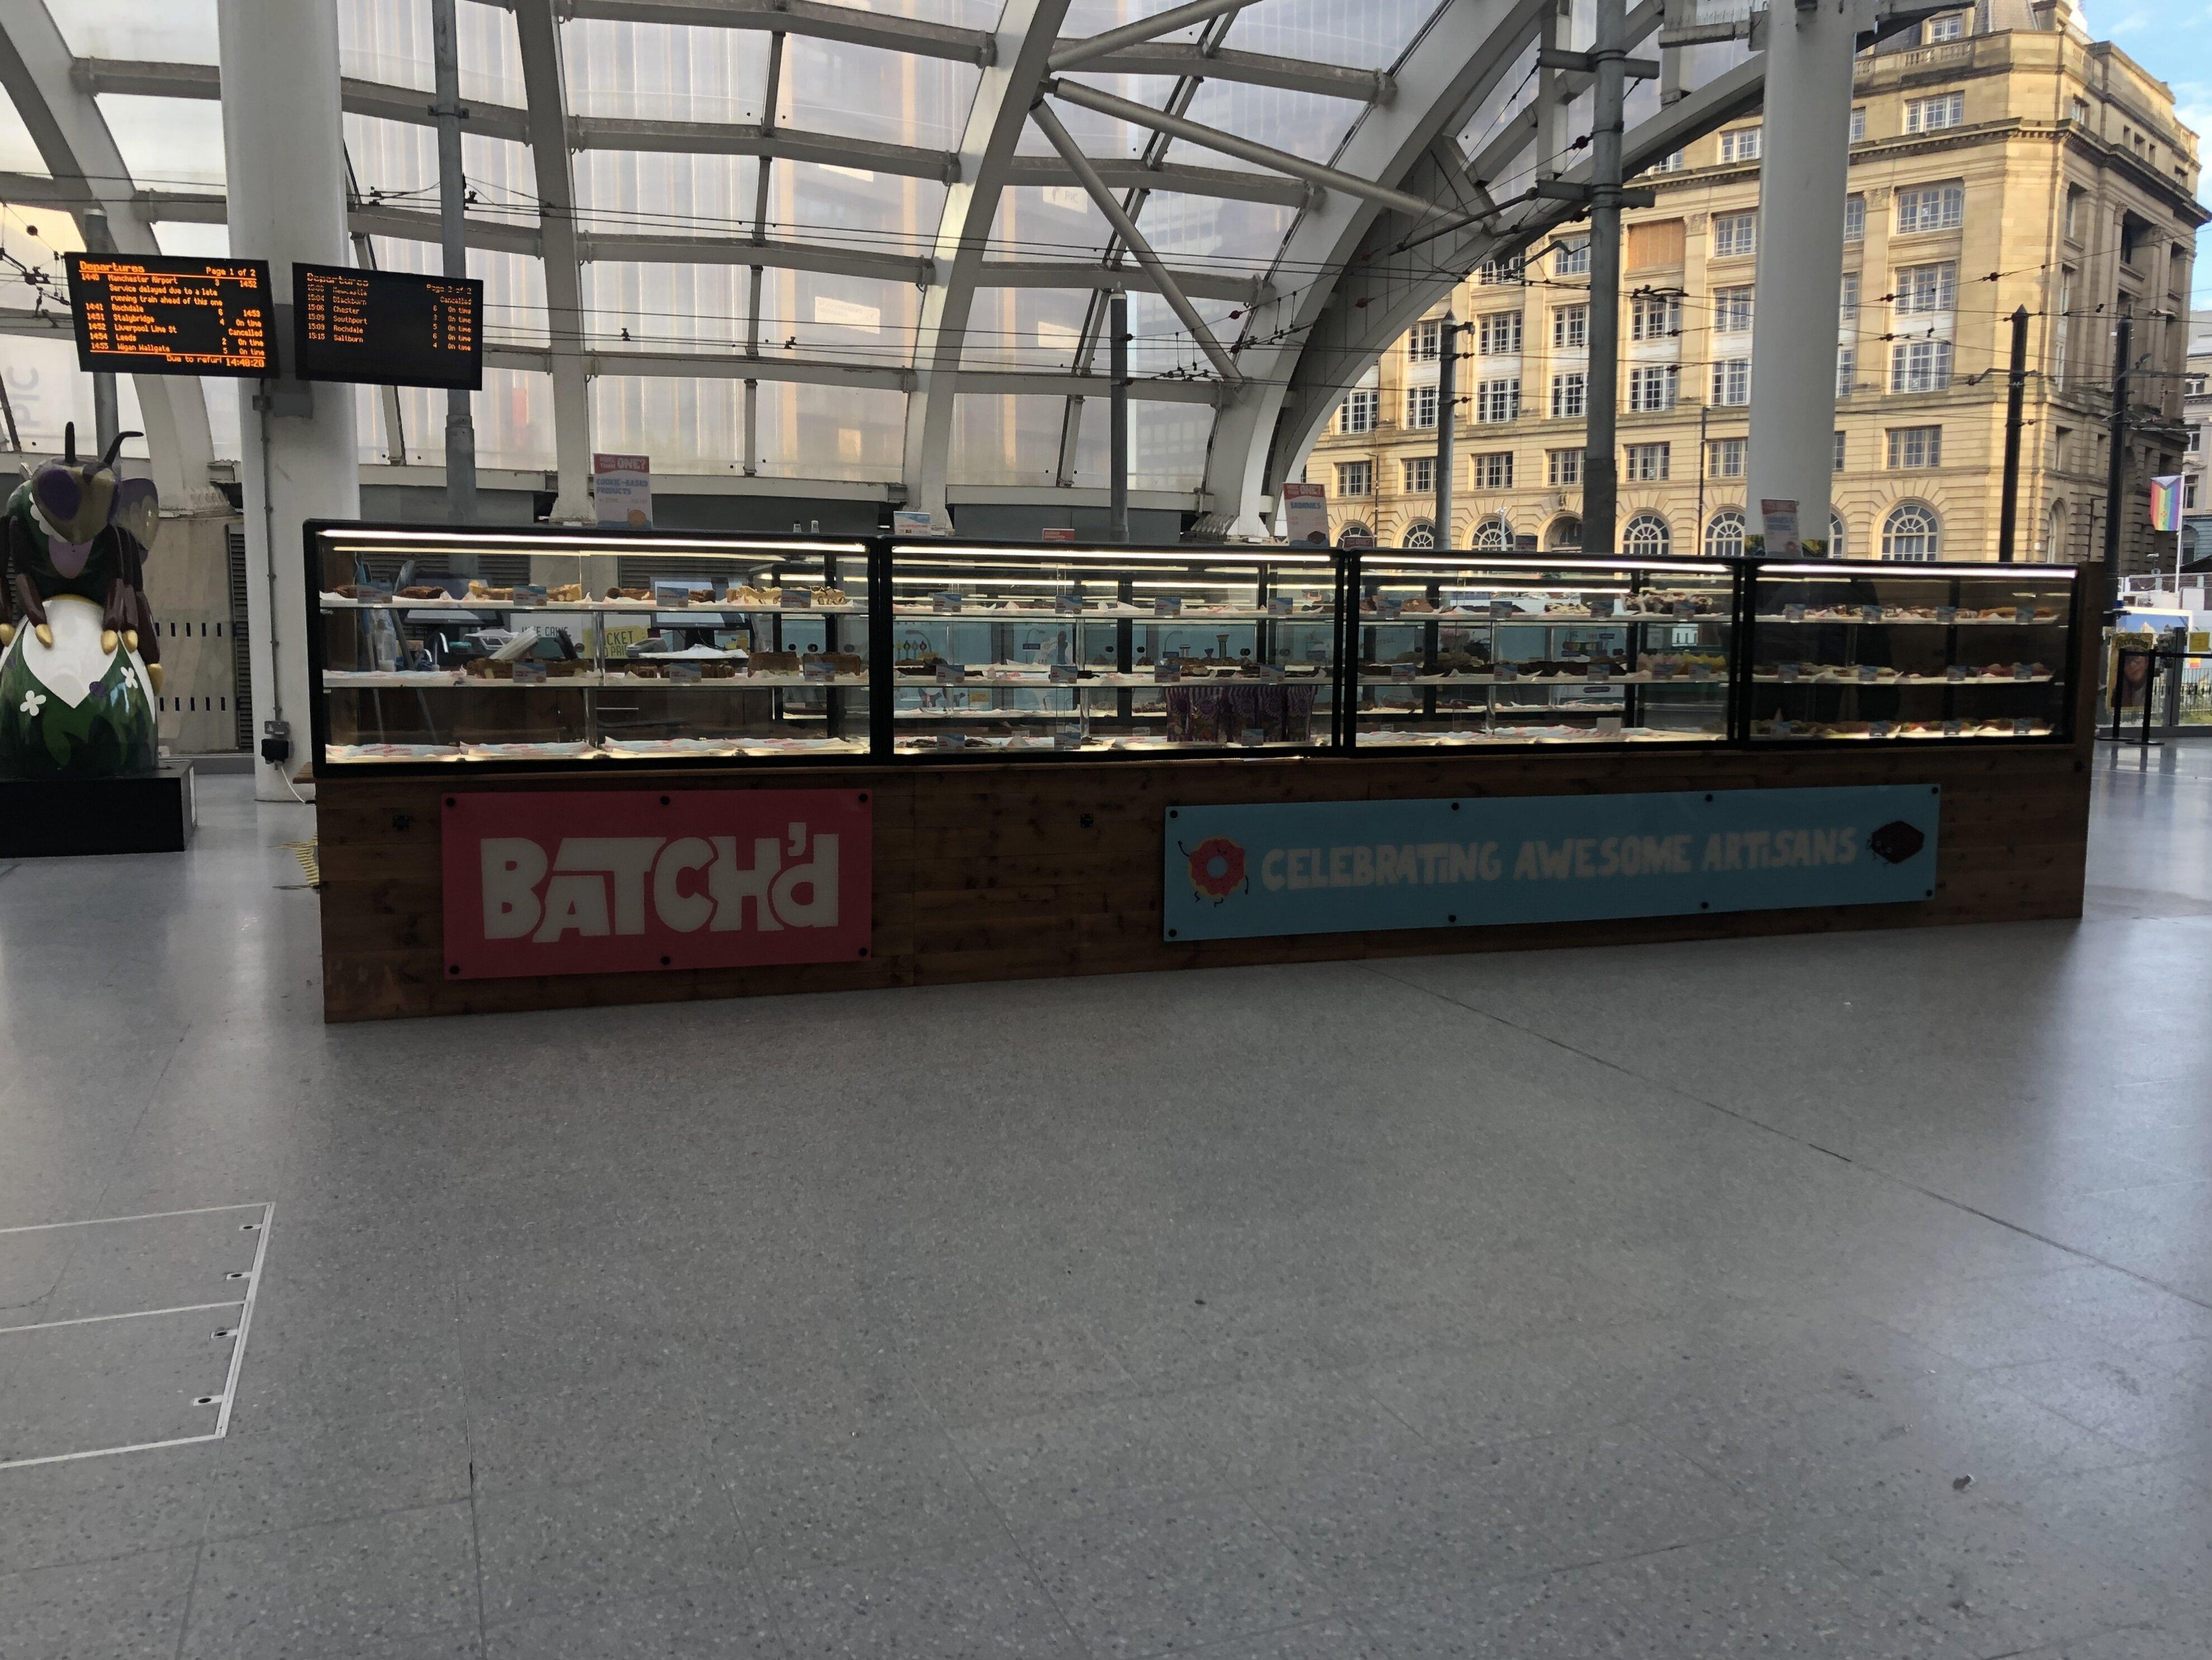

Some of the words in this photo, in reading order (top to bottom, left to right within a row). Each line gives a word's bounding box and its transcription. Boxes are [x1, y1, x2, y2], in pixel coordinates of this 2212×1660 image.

[79, 260, 145, 273] Departures
[206, 267, 226, 276] Page
[108, 274, 149, 283] Manchester
[151, 276, 178, 284] Airport
[307, 273, 369, 286] Departures
[426, 284, 444, 293] Page
[109, 284, 136, 292] Service
[139, 286, 167, 295] delayed
[111, 295, 137, 303] running
[112, 303, 144, 312] Rochdale
[333, 306, 359, 314] Chester
[113, 314, 155, 324] Stalybridge
[333, 315, 368, 325] Southport
[115, 324, 149, 333] Liverpool
[228, 328, 263, 336] Cancelled
[334, 325, 363, 334] Rochdale
[334, 334, 363, 343] Saltburn
[117, 343, 136, 352] Wigan
[139, 344, 170, 353] Wallgate
[1261, 840, 1502, 891] CELEBRATING
[1513, 833, 1693, 881] AWESOME
[1700, 826, 1857, 871] ARTISANS
